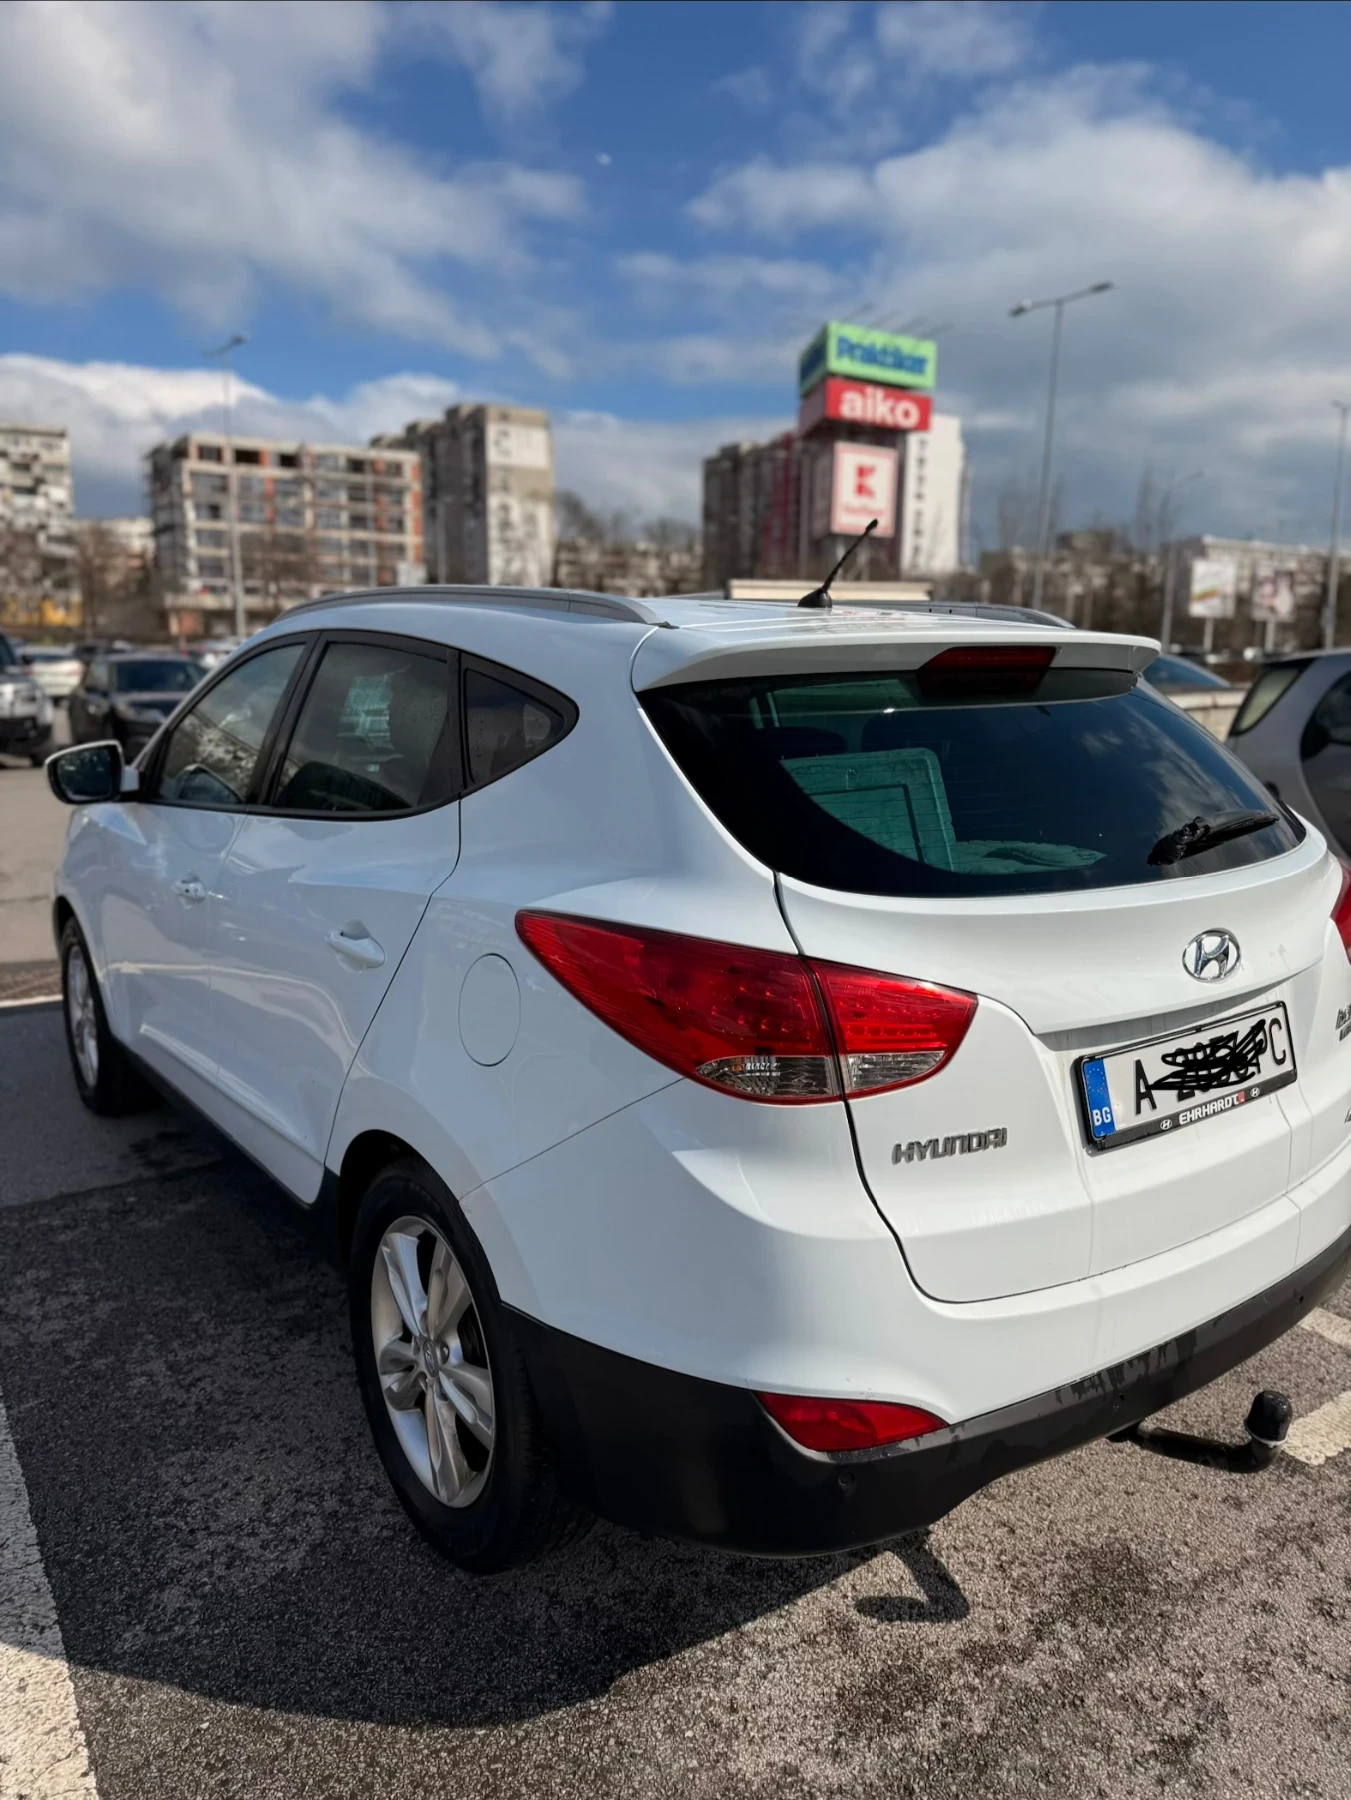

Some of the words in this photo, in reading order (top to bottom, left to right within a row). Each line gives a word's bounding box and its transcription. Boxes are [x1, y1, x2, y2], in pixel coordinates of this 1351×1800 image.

[840, 385, 920, 428] aiko
[855, 464, 877, 498] K
[1092, 1106, 1111, 1126] BG
[891, 1127, 1008, 1165] HYUNDAI
